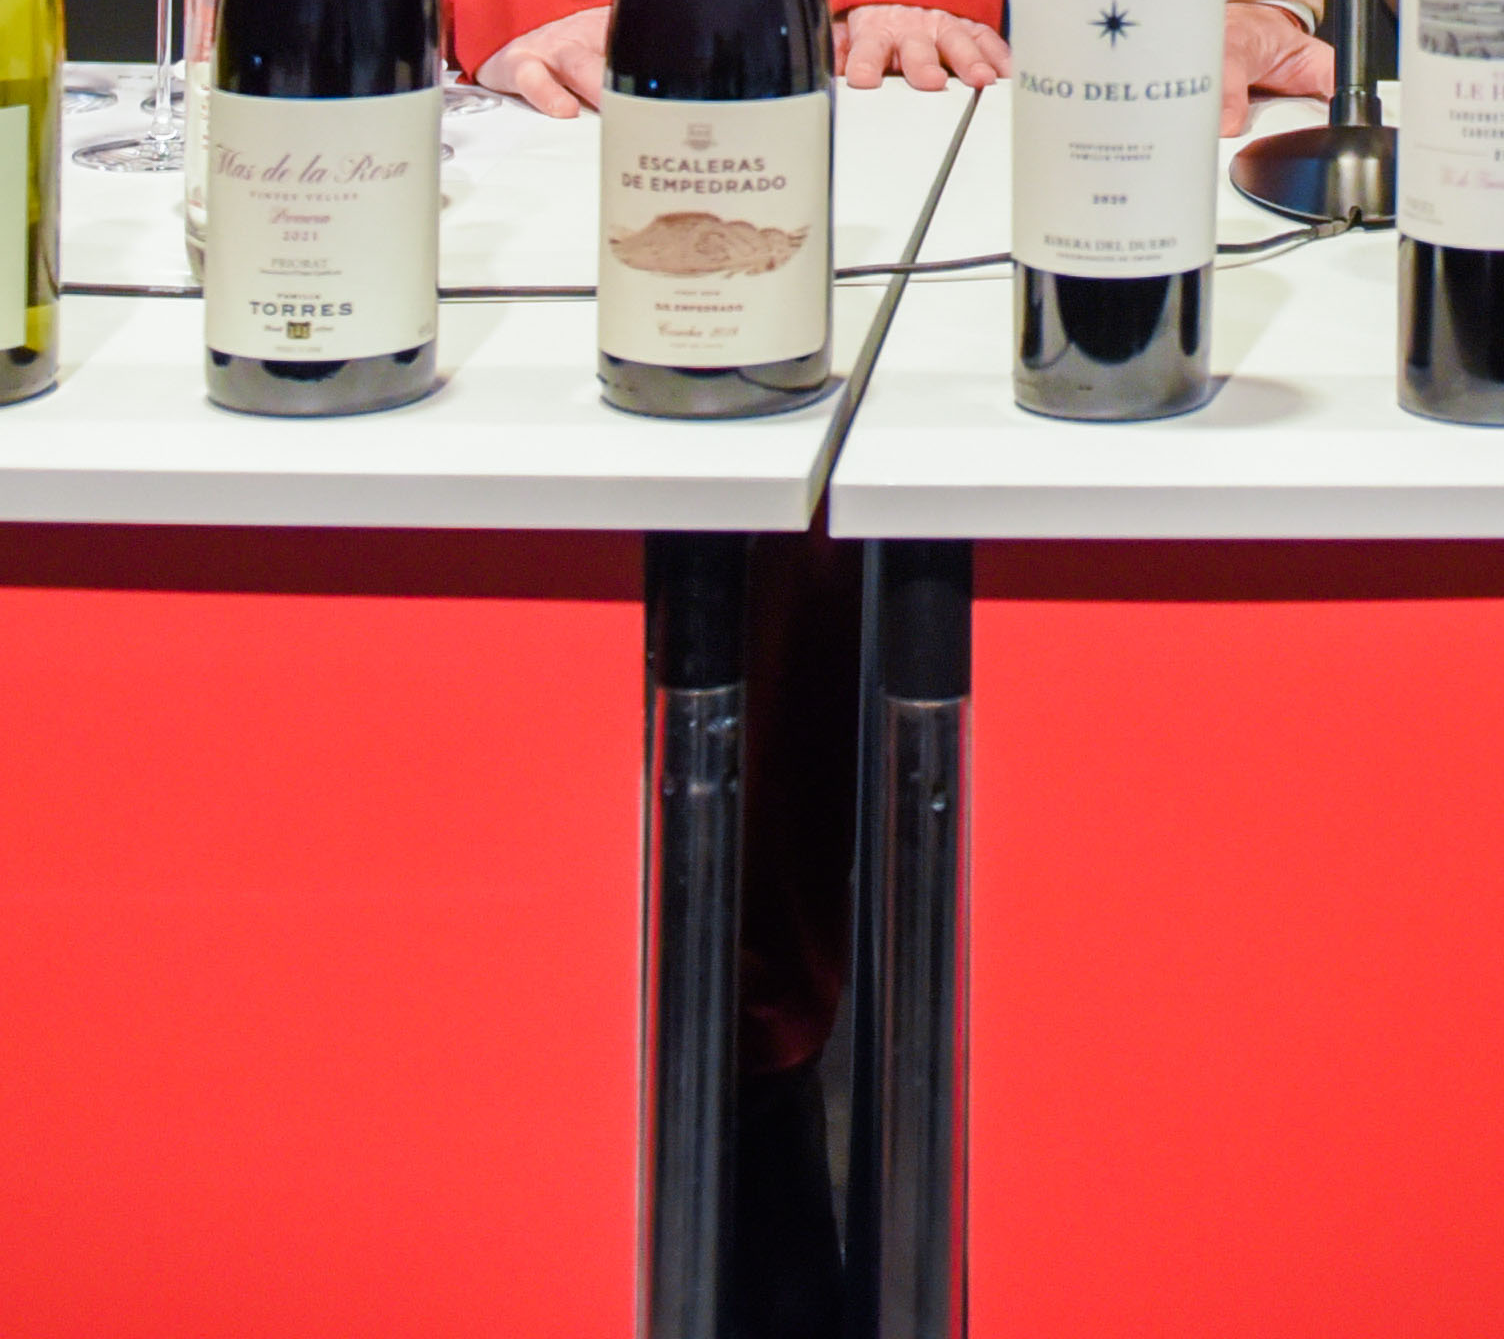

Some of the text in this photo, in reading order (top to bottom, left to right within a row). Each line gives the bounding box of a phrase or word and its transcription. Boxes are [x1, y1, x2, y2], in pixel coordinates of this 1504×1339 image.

[1020, 71, 1211, 102] PAGO DEL CIELO
[1455, 81, 1483, 100] LE
[261, 153, 290, 183] de
[299, 154, 329, 184] la
[334, 154, 410, 184] Rosa
[639, 154, 766, 174] ESCALERAS
[621, 173, 787, 194] DE EMPEDRADO
[1043, 234, 1178, 252] RIBERA DEL DUERO
[248, 300, 354, 317] TORRES
